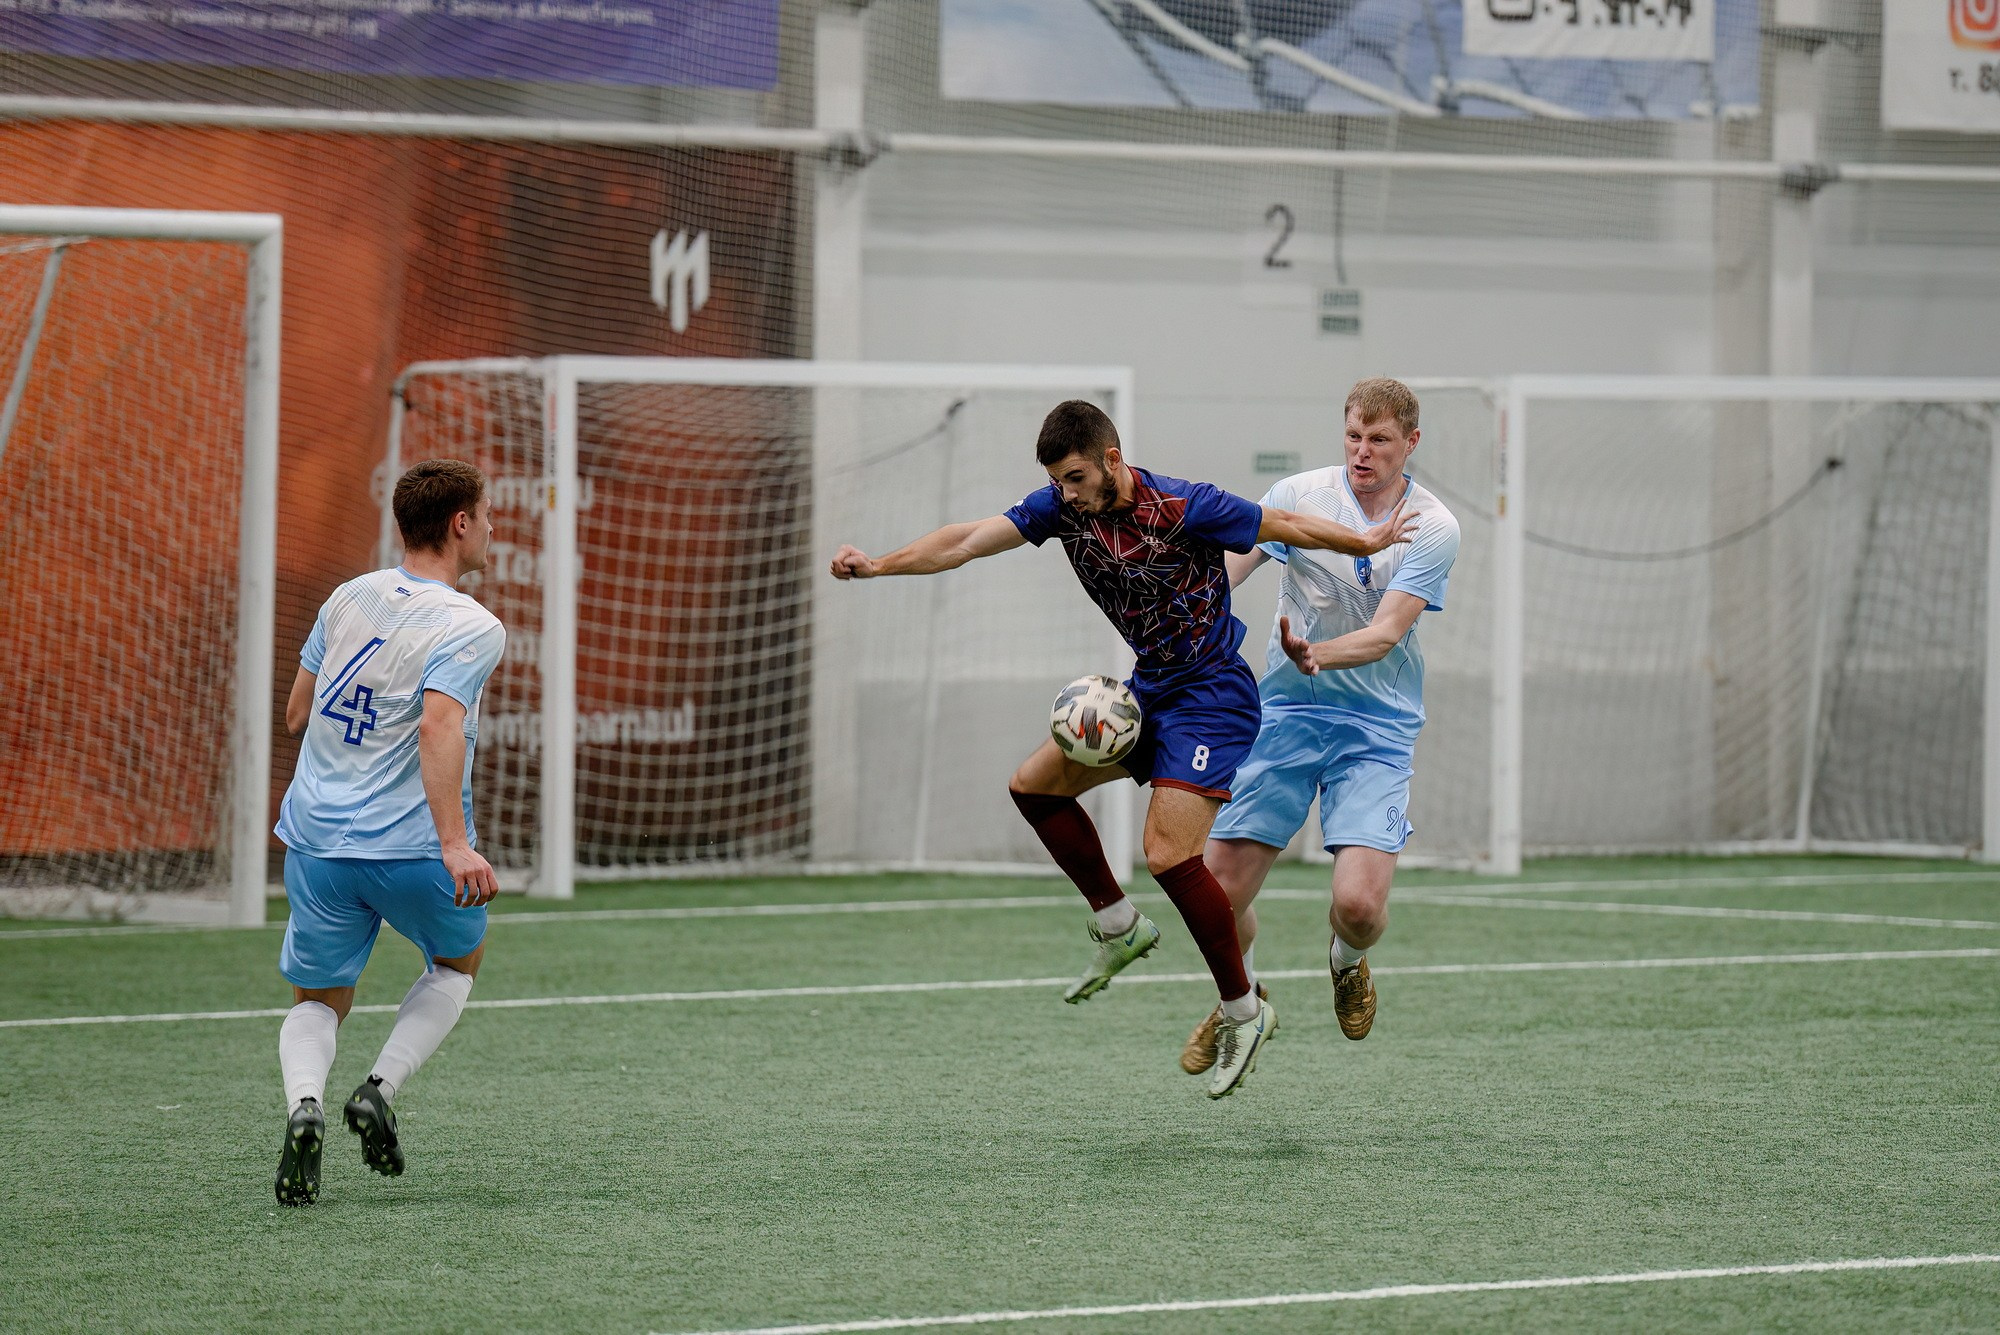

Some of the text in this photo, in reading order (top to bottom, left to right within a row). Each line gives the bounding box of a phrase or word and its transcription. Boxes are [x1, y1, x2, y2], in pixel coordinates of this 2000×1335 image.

[1264, 204, 1296, 268] 2
[319, 637, 387, 746] 4
[1191, 744, 1210, 772] 8
[1386, 805, 1405, 832] 9
